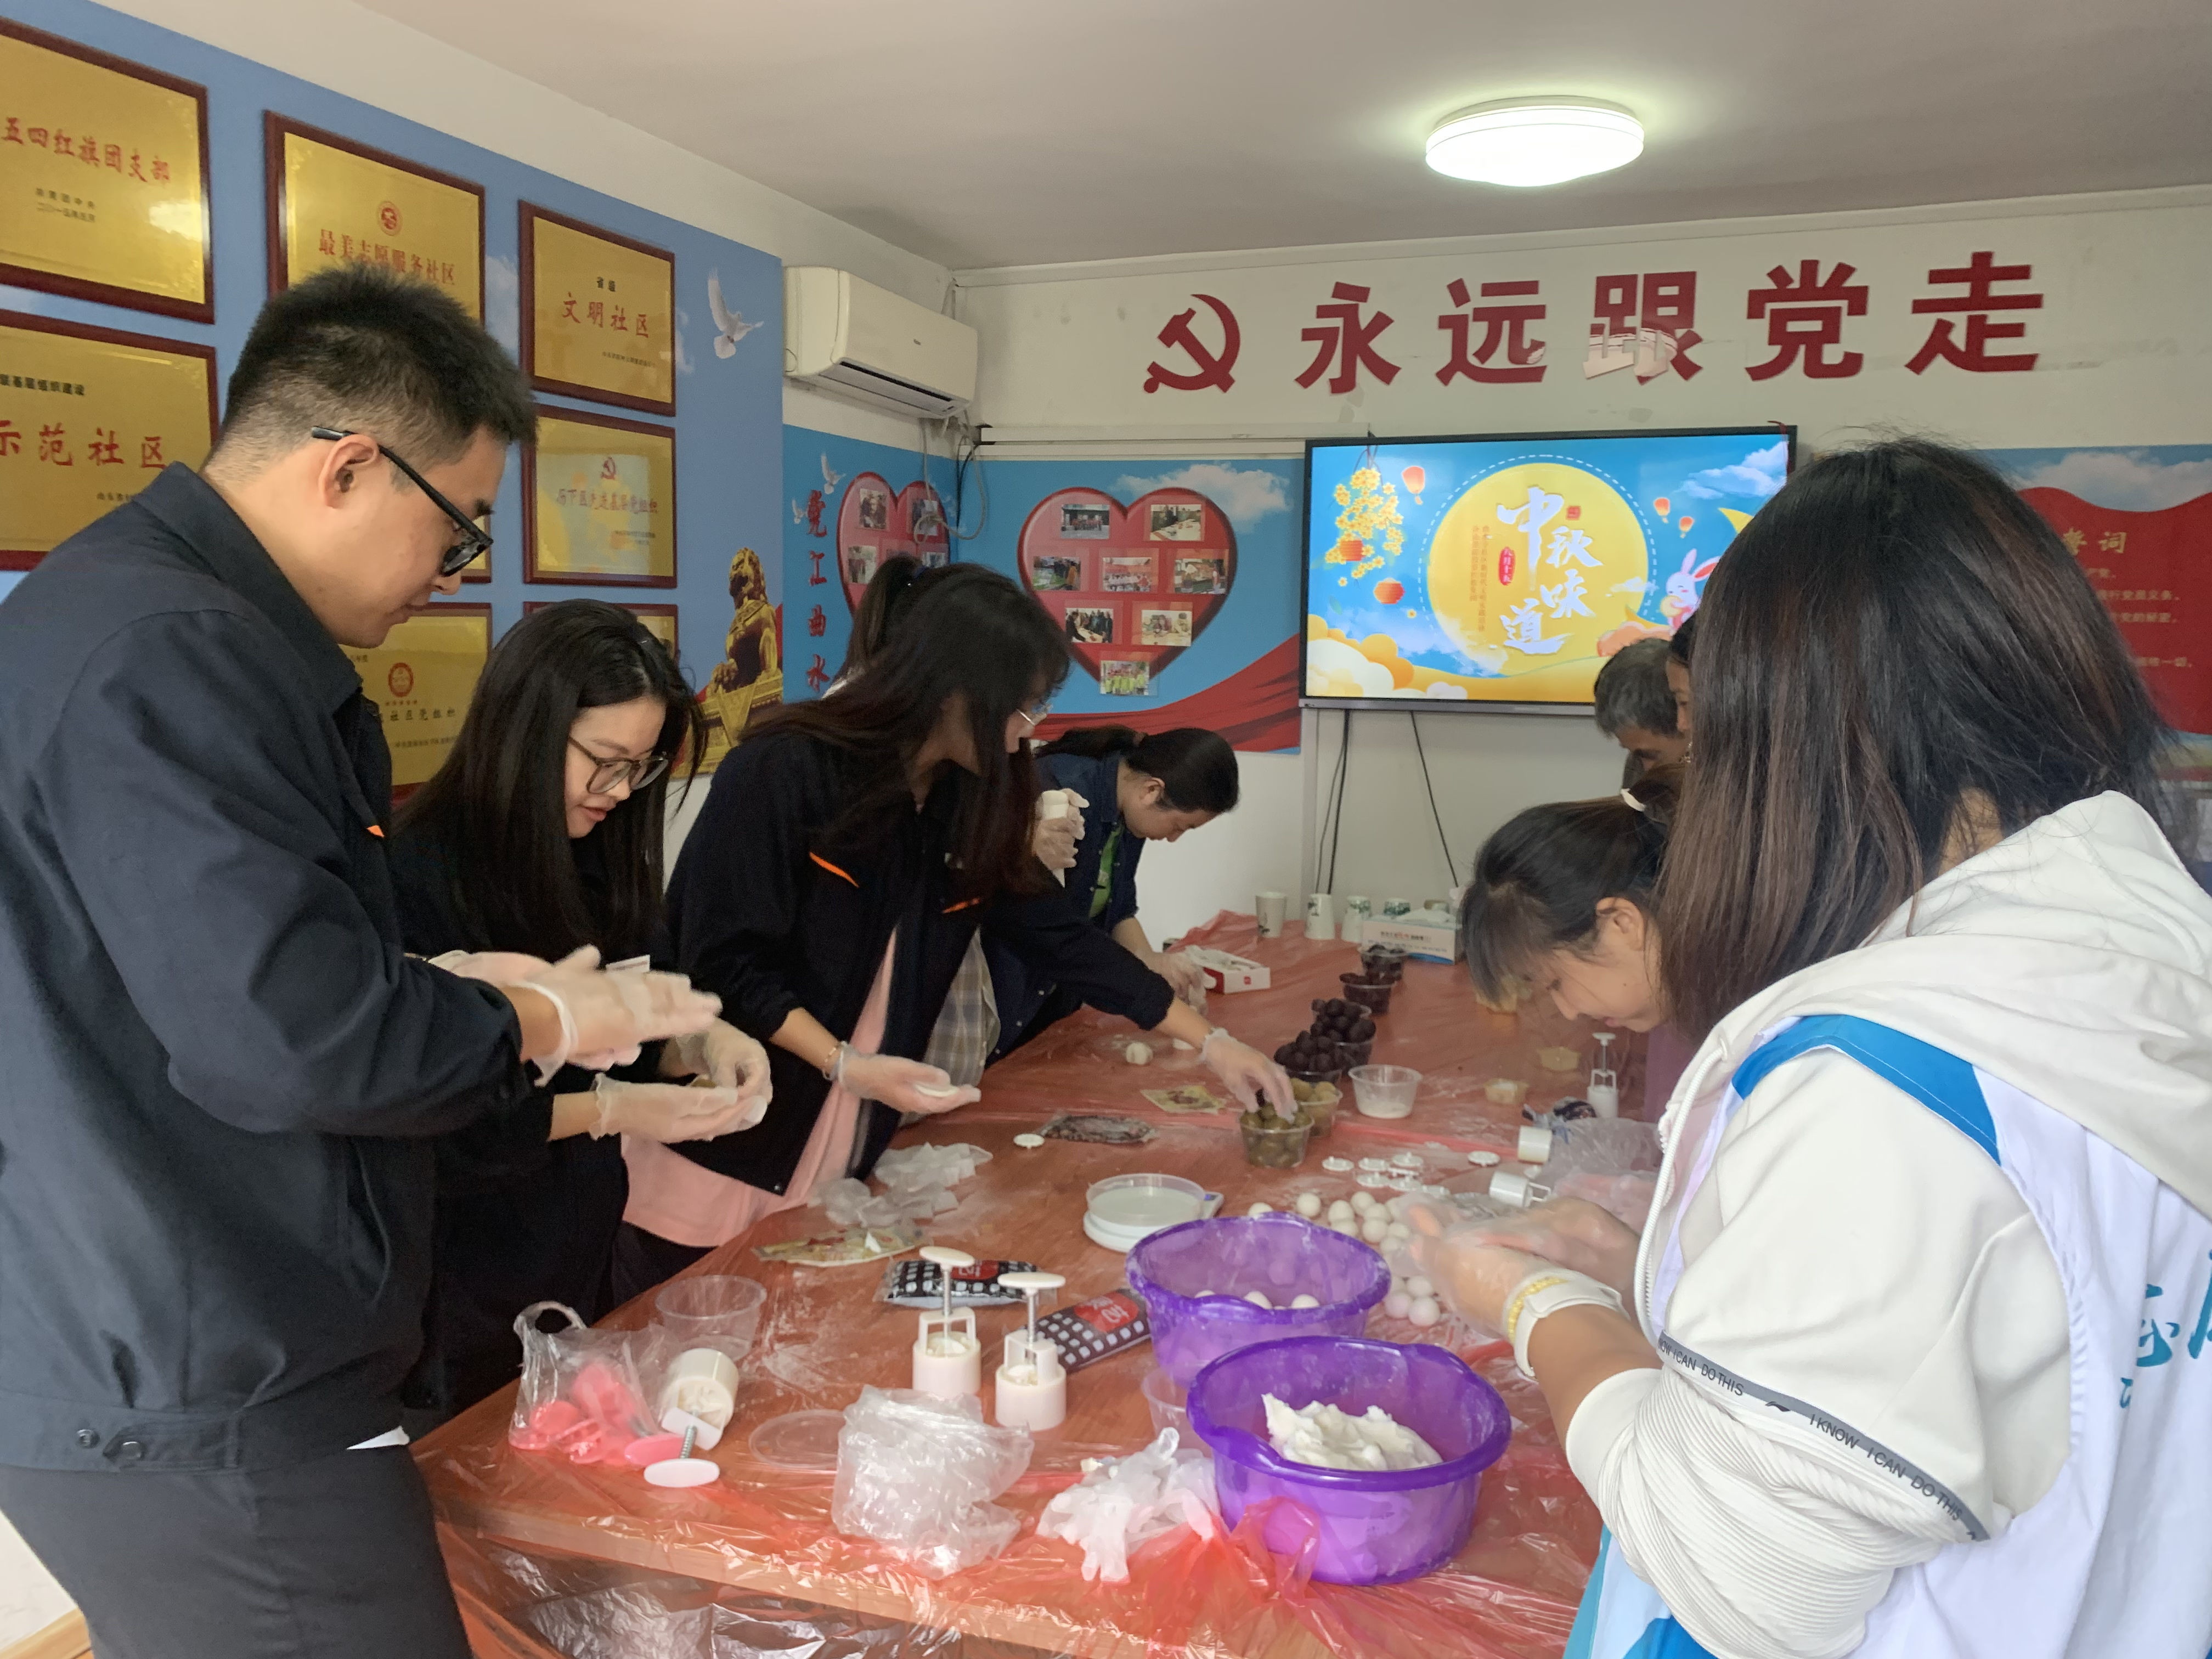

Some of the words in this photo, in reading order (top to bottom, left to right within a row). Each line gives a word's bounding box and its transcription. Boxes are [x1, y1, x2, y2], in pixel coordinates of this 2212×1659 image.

[3, 117, 171, 183] 五四红旗团支部
[562, 291, 650, 338] 文明社区
[1295, 252, 2043, 394] 永远跟党走
[1496, 486, 1605, 654] 中秋味道
[1676, 1351, 1697, 1371] CAN
[1701, 1363, 1716, 1380] DO
[1718, 1372, 1744, 1396] THIS
[1810, 1414, 1815, 1425] I
[1816, 1417, 1860, 1449] KNOW
[1867, 1447, 1874, 1458] I
[1874, 1452, 1906, 1478] CAN
[1911, 1475, 1936, 1497] DO
[1937, 1492, 1963, 1521] THIS
